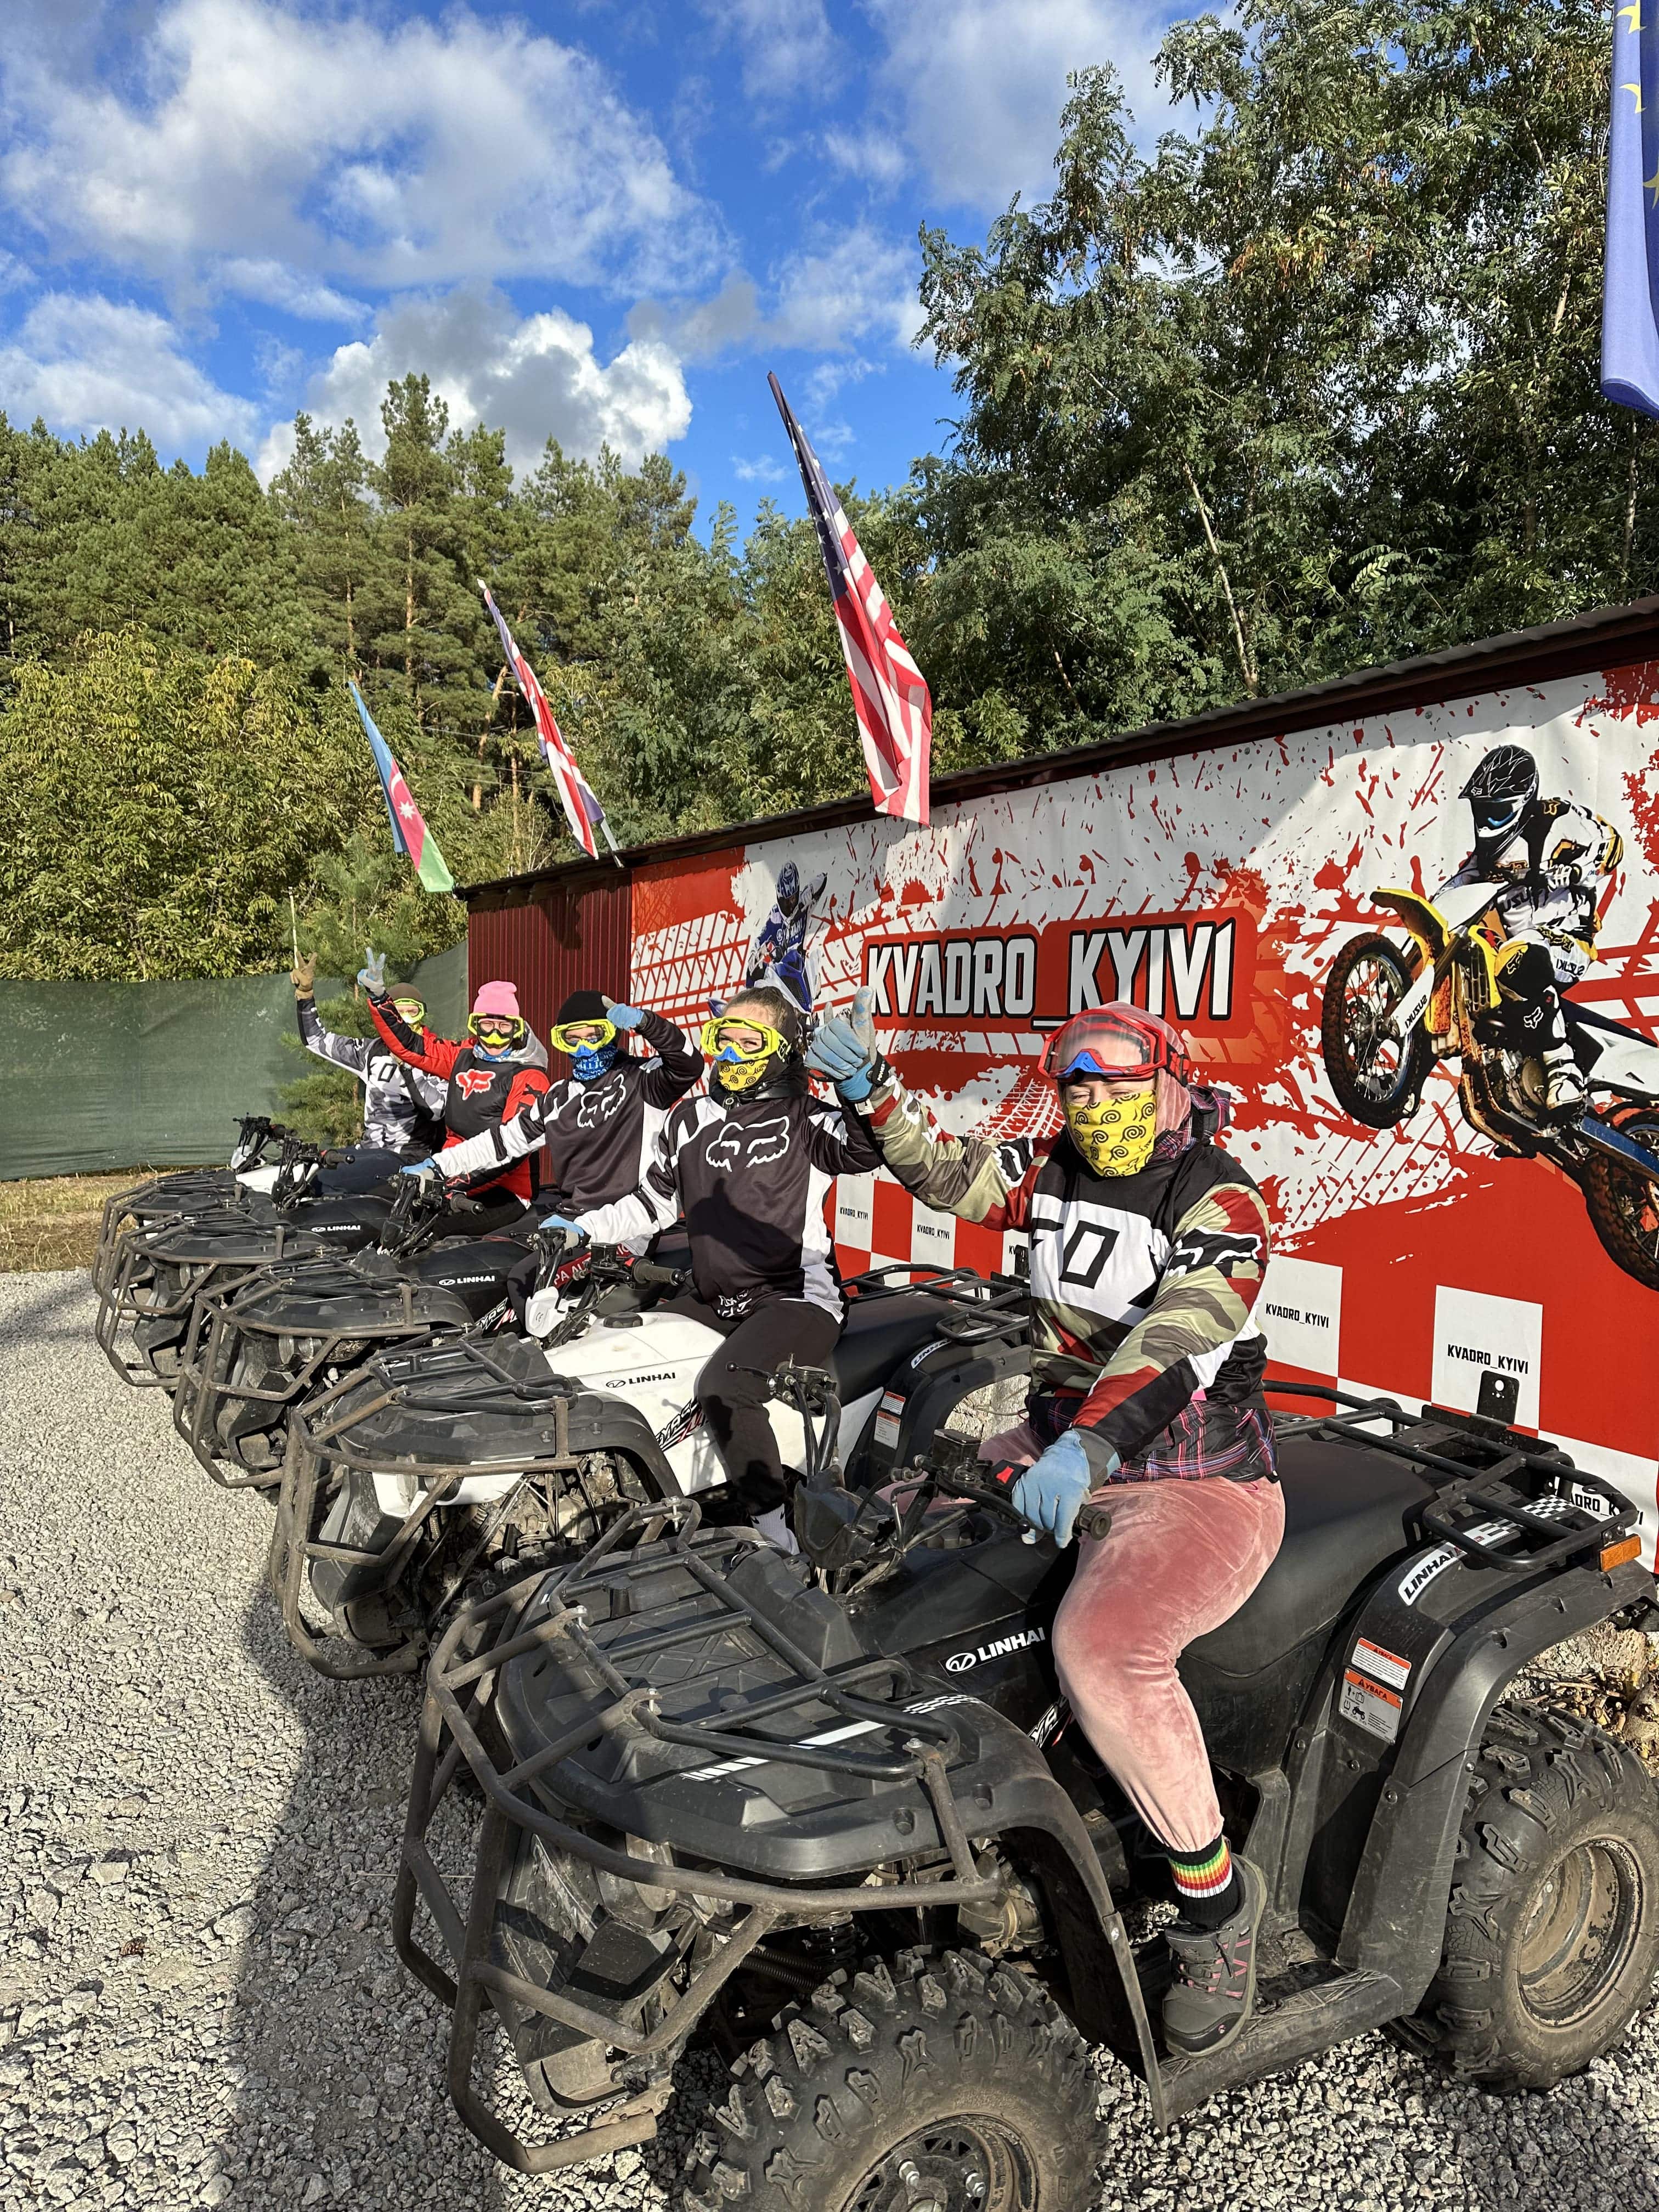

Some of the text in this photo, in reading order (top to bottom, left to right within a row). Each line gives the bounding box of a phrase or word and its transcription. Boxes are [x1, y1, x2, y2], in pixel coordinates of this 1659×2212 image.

[456, 1276, 495, 1284] LINHAI
[628, 1372, 676, 1384] LINHAI
[1404, 1549, 1453, 1600] LINHAI
[977, 1627, 1046, 1661] LINHAI
[1364, 1684, 1388, 1701] УВАГА
